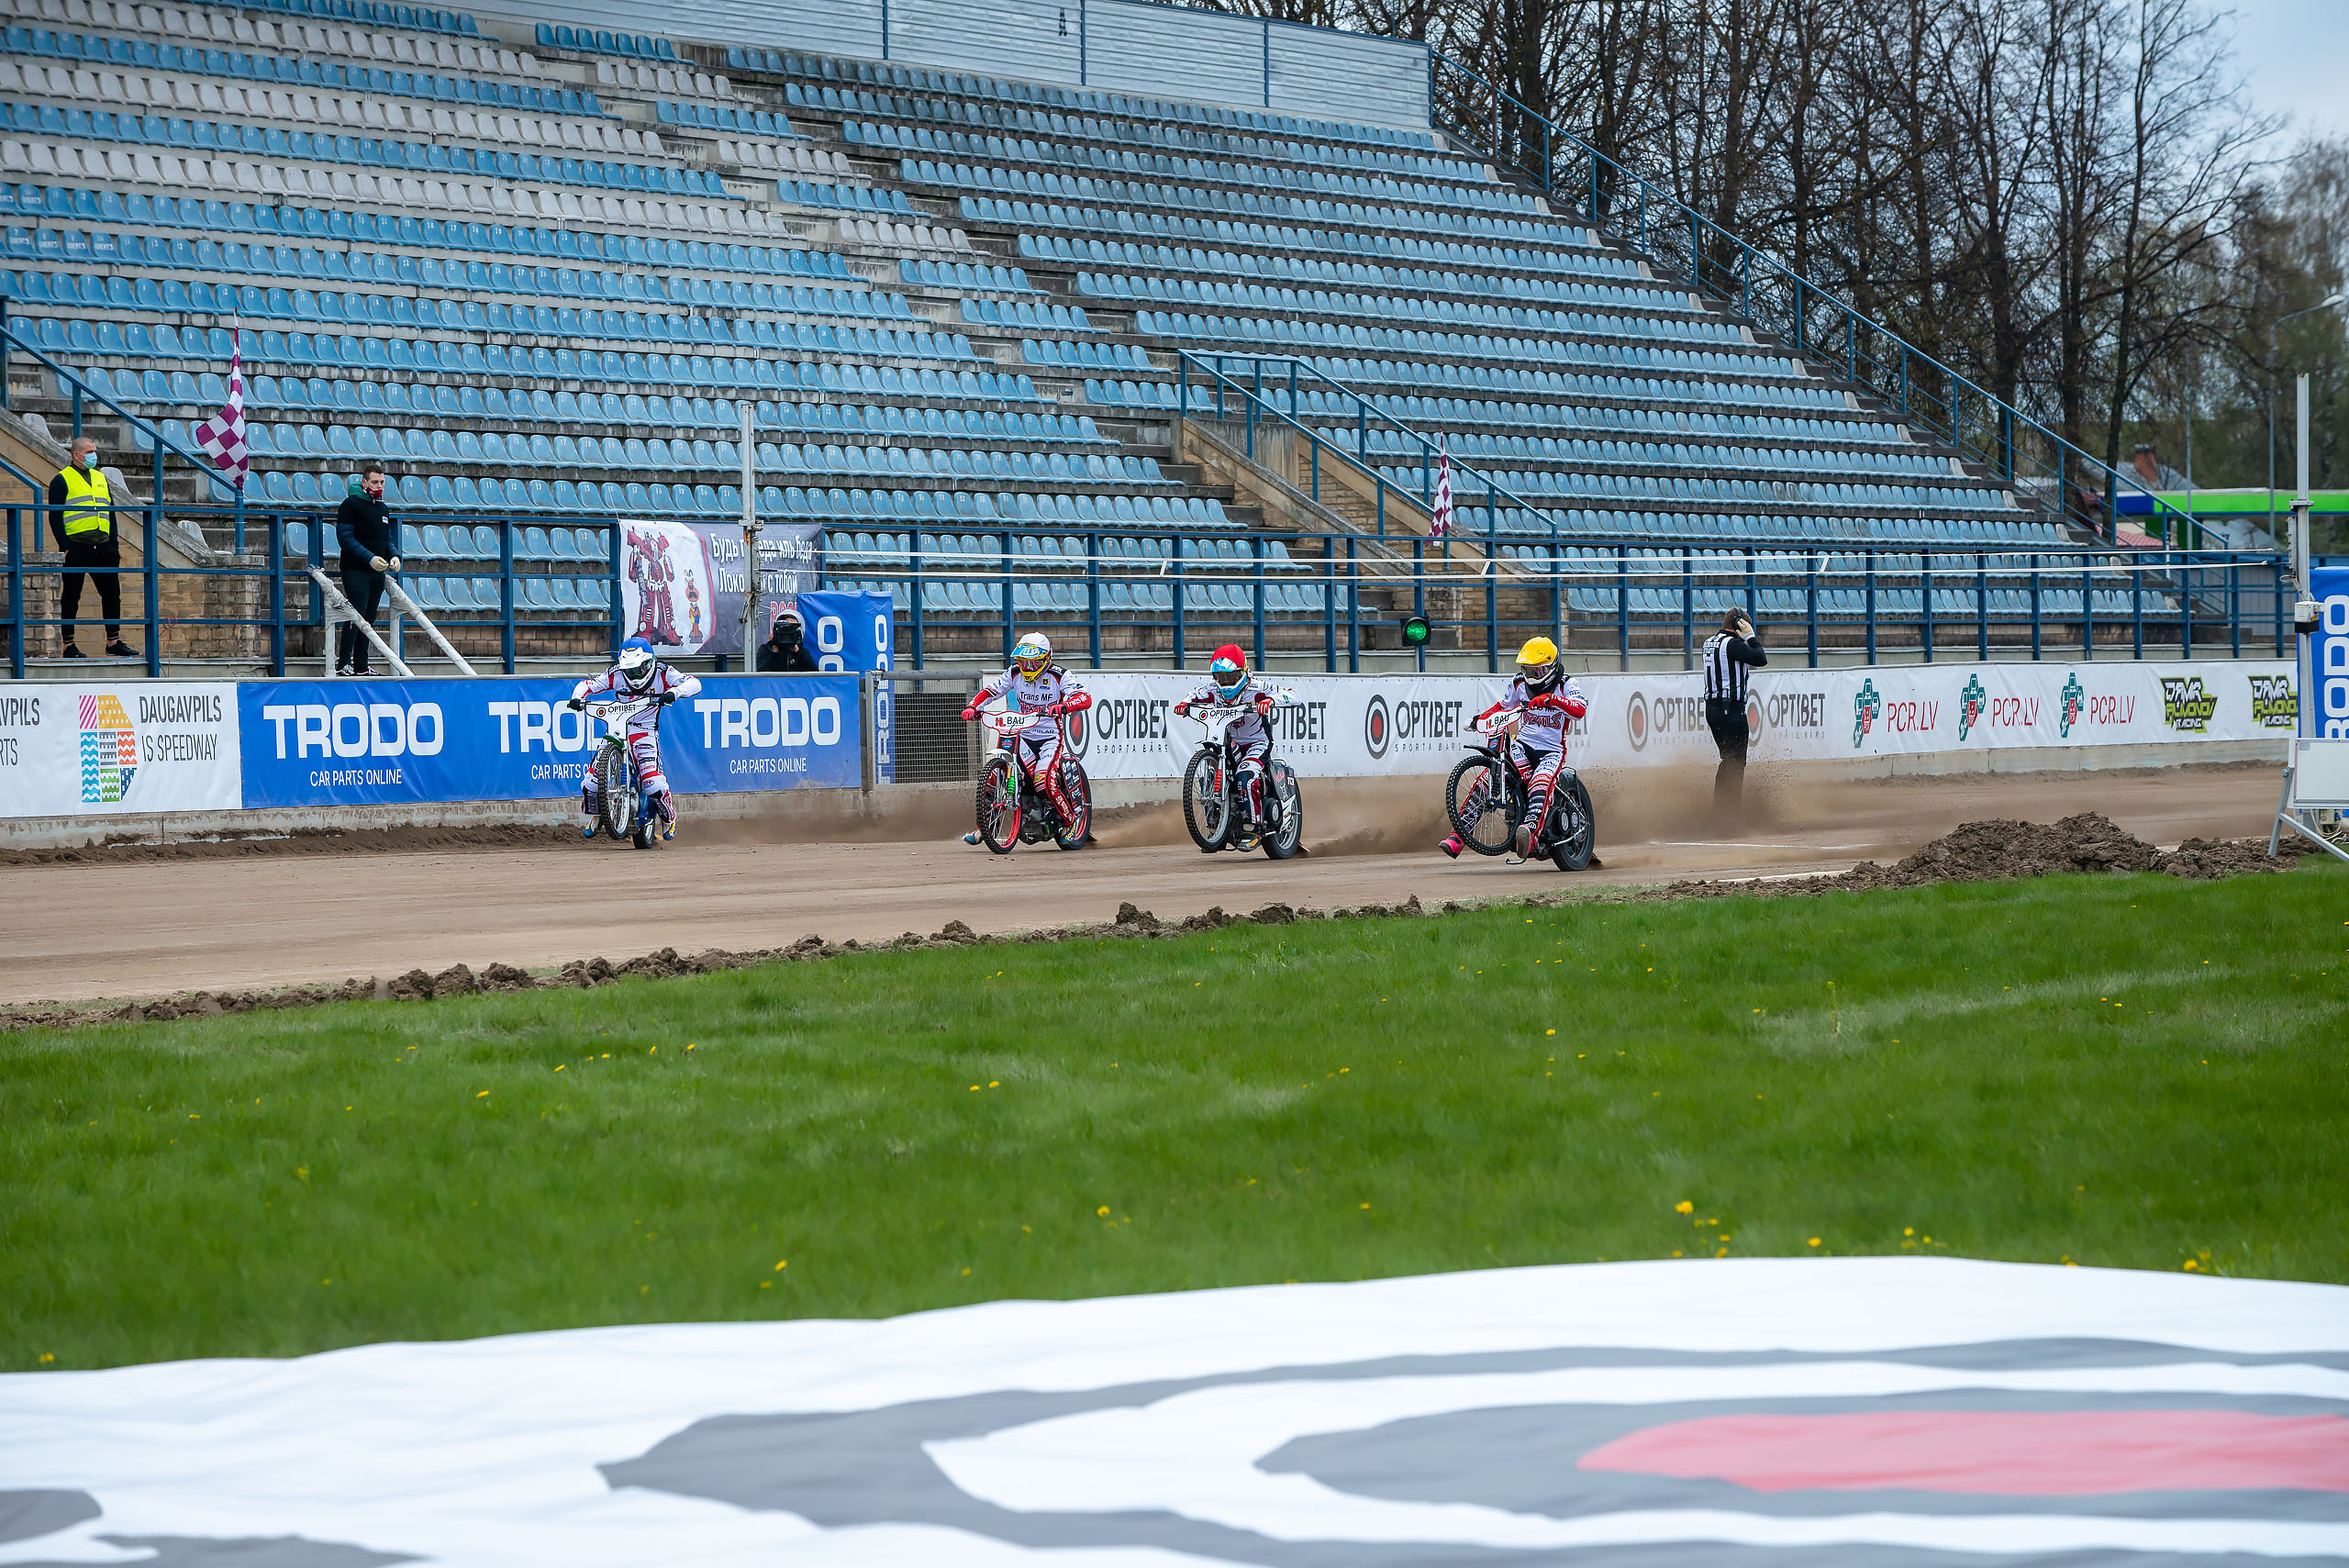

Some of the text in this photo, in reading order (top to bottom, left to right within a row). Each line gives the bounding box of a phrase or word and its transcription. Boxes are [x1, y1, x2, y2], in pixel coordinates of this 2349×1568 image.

[2323, 595, 2349, 740] RODO
[0, 697, 40, 726] VPILS
[139, 695, 222, 724] DAUGAVPILS
[607, 704, 637, 714] OPTIBET
[1019, 691, 1053, 702] Trans MF
[1767, 694, 1826, 728] OPTIBET
[1992, 696, 2040, 728] PCR.LV
[2090, 695, 2135, 725] PCR.LV
[488, 700, 606, 753] TRO
[695, 696, 841, 750] TRODO
[1096, 698, 1170, 740] OPTIBET
[1269, 701, 1327, 740] PTIBET
[1395, 700, 1463, 740] OPTIBET
[1653, 696, 1709, 733] OPTIBE
[1887, 700, 1939, 732] PCR.LV
[262, 702, 444, 760] TRODO
[1395, 742, 1431, 751] SPORTA
[141, 733, 217, 762] IS SPEEDWAY
[1097, 744, 1137, 753] SPORTA
[310, 768, 402, 787] CAR PARTS ONLINE
[531, 764, 551, 780] CAR
[552, 763, 582, 779] PARTS
[729, 757, 807, 774] CAR PARTS ONLINE
